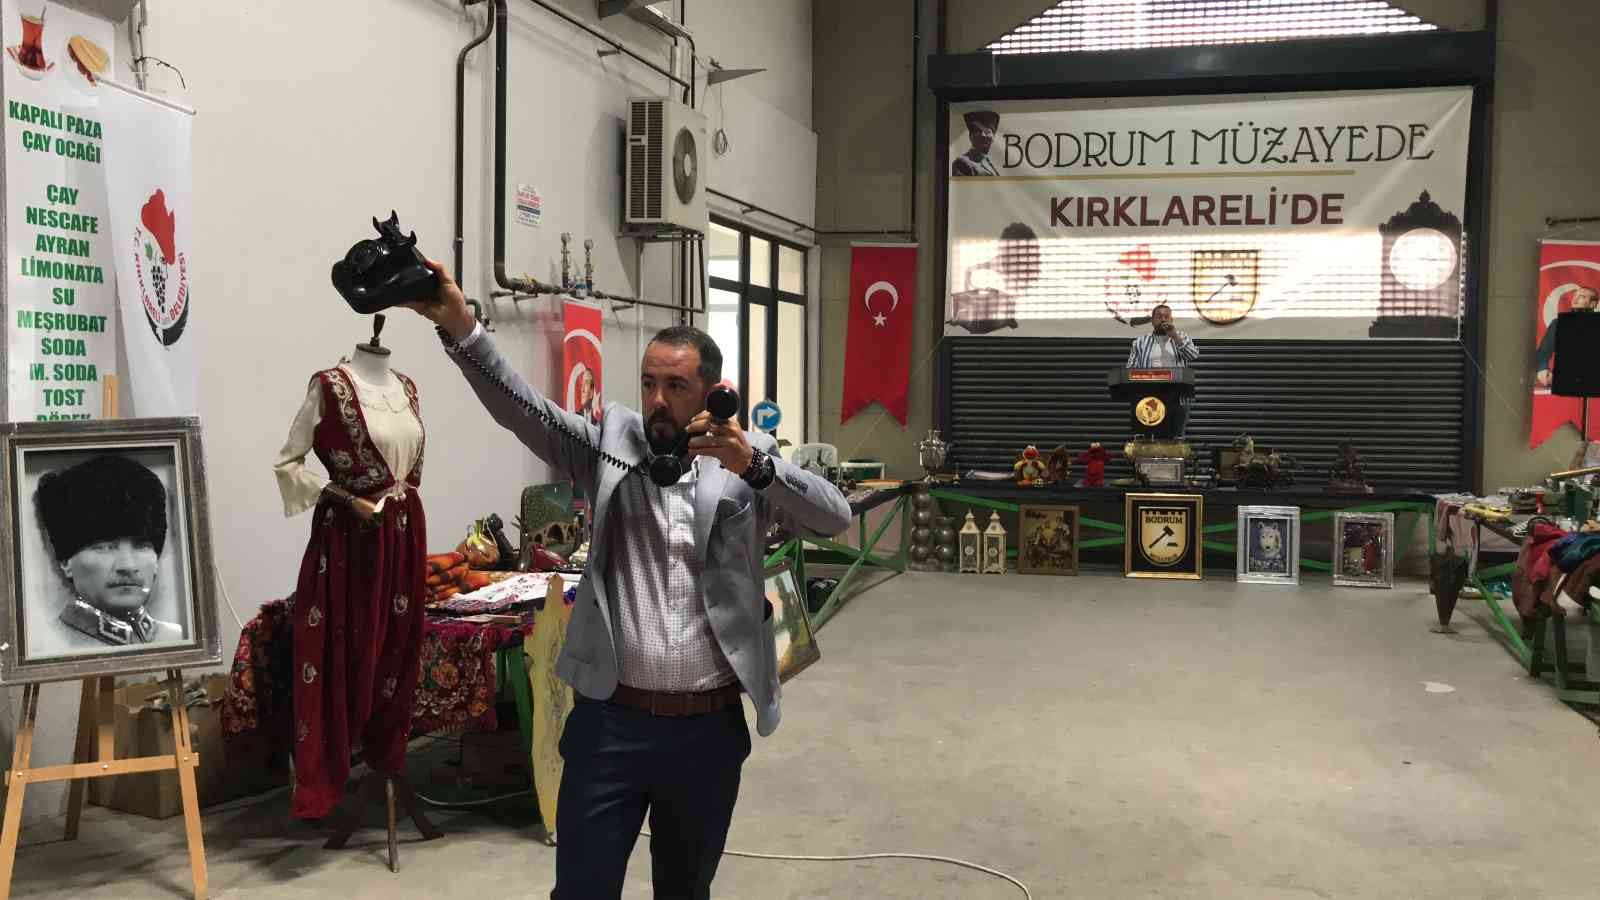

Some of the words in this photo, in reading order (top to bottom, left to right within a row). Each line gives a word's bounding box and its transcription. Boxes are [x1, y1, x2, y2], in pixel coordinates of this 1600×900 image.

[8, 100, 63, 130] KAPALI
[22, 130, 51, 153] ÇAY
[55, 138, 101, 164] OCAĞI
[1002, 129, 1176, 169] BODRUM
[1190, 121, 1435, 165] MÜZAYEDE
[47, 185, 79, 206] ÇAY
[1050, 186, 1345, 227] KIRKLARELİ'DE
[26, 207, 98, 234] NESCAFE
[35, 233, 90, 258] AYRAN
[21, 256, 104, 284] LİMONATA
[52, 287, 75, 306] SU
[17, 310, 107, 333] MEŞRUBAT
[41, 337, 86, 357] SODA
[29, 363, 48, 382] M.
[53, 364, 98, 382] SODA
[43, 389, 85, 407] TOST
[1145, 515, 1183, 525] BODRUM
